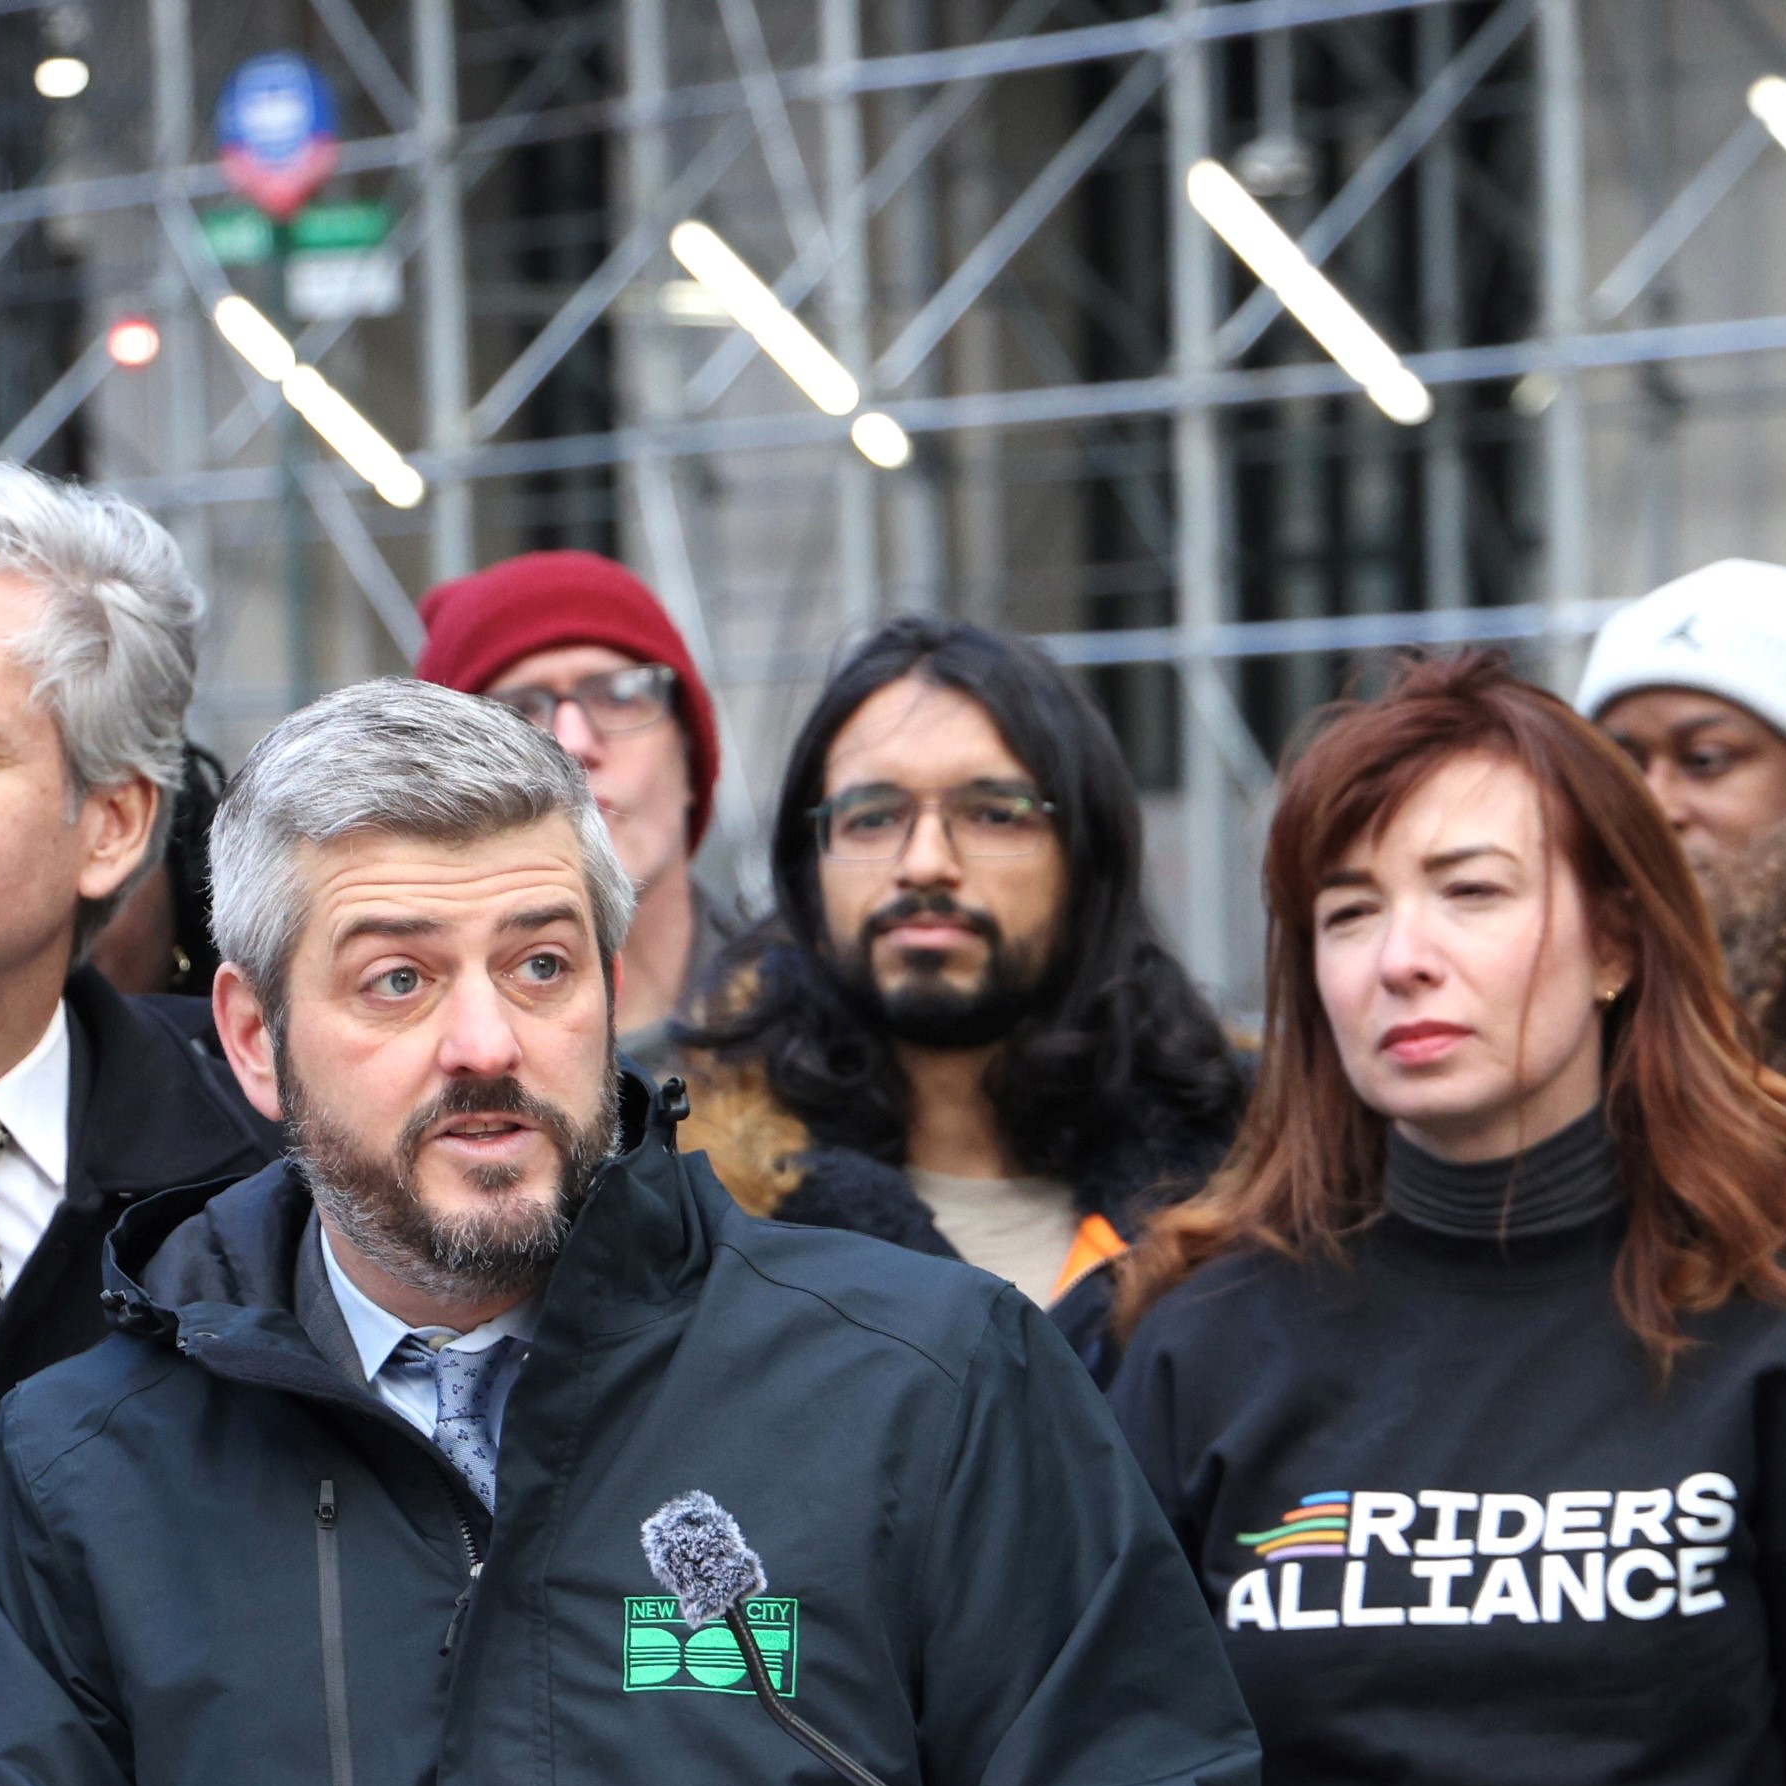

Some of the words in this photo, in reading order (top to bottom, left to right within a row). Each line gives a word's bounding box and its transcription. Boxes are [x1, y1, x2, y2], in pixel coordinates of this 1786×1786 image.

[1347, 1471, 1738, 1559] RIDERS
[631, 1602, 677, 1620] NEW
[745, 1602, 791, 1622] CITY
[1226, 1545, 1729, 1631] ALLIANCE
